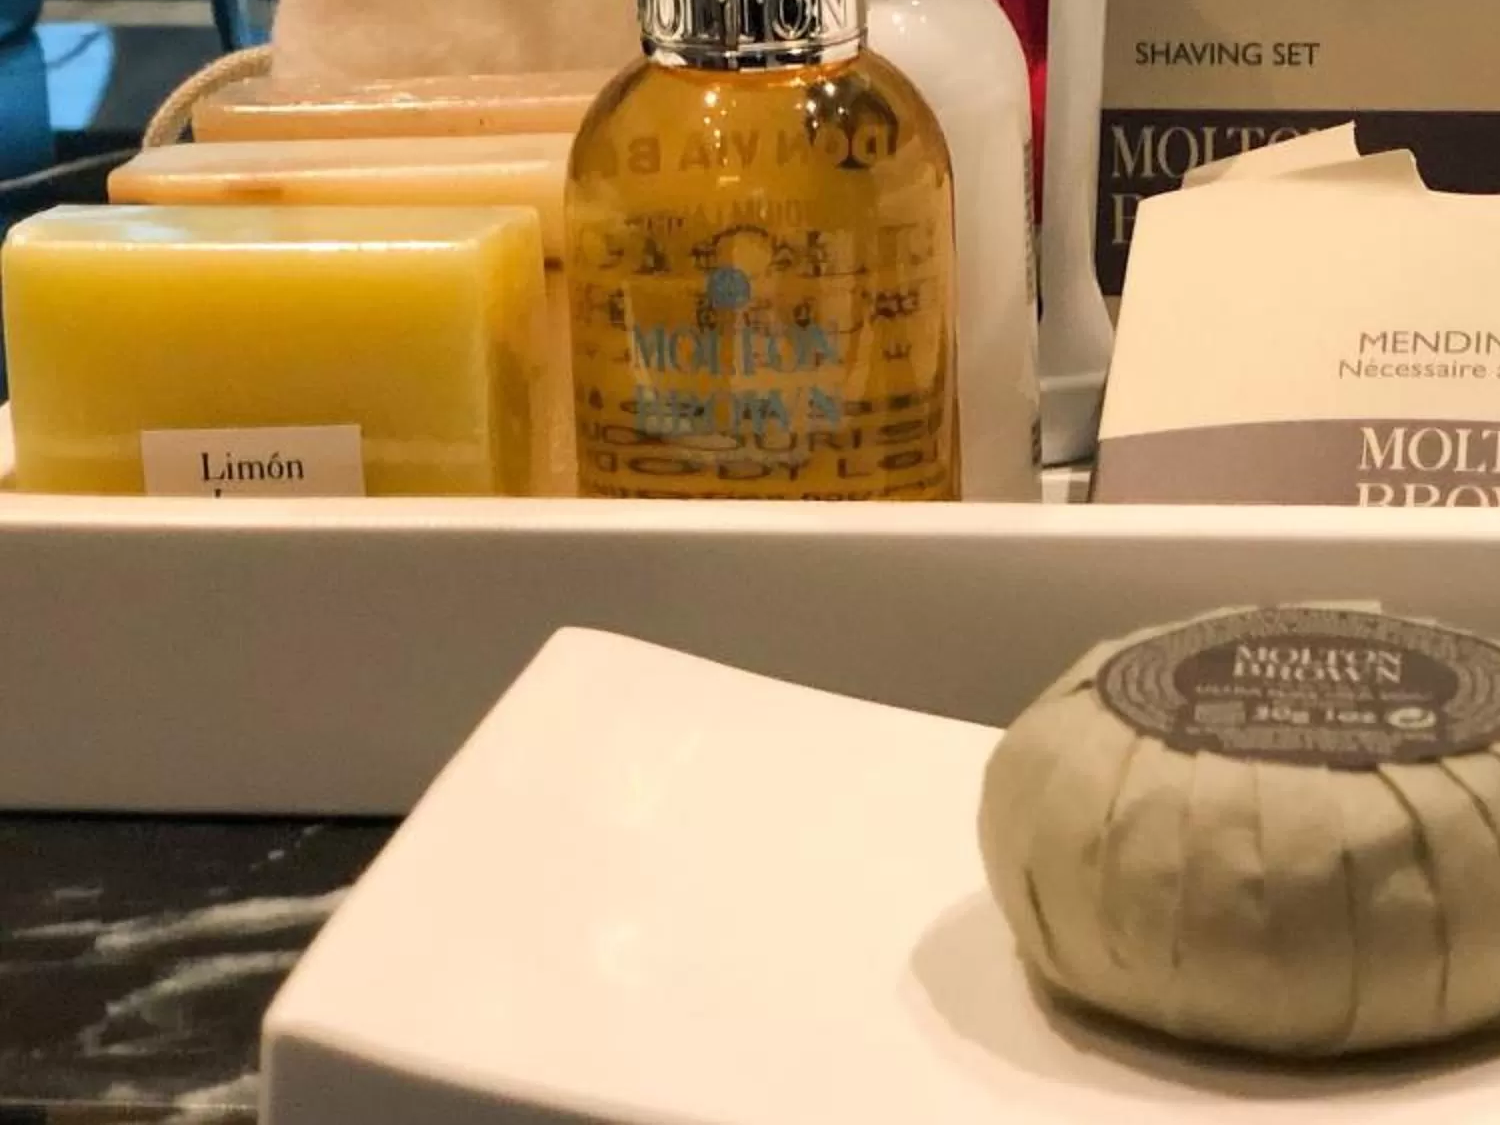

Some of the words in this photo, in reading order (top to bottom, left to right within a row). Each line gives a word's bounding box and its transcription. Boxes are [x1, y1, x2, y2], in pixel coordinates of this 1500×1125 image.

[1135, 41, 1263, 67] SHAVING
[1272, 42, 1321, 67] SET
[1111, 125, 1322, 179] MOLT
[1338, 359, 1488, 379] Nécessaire
[201, 452, 305, 481] Limón
